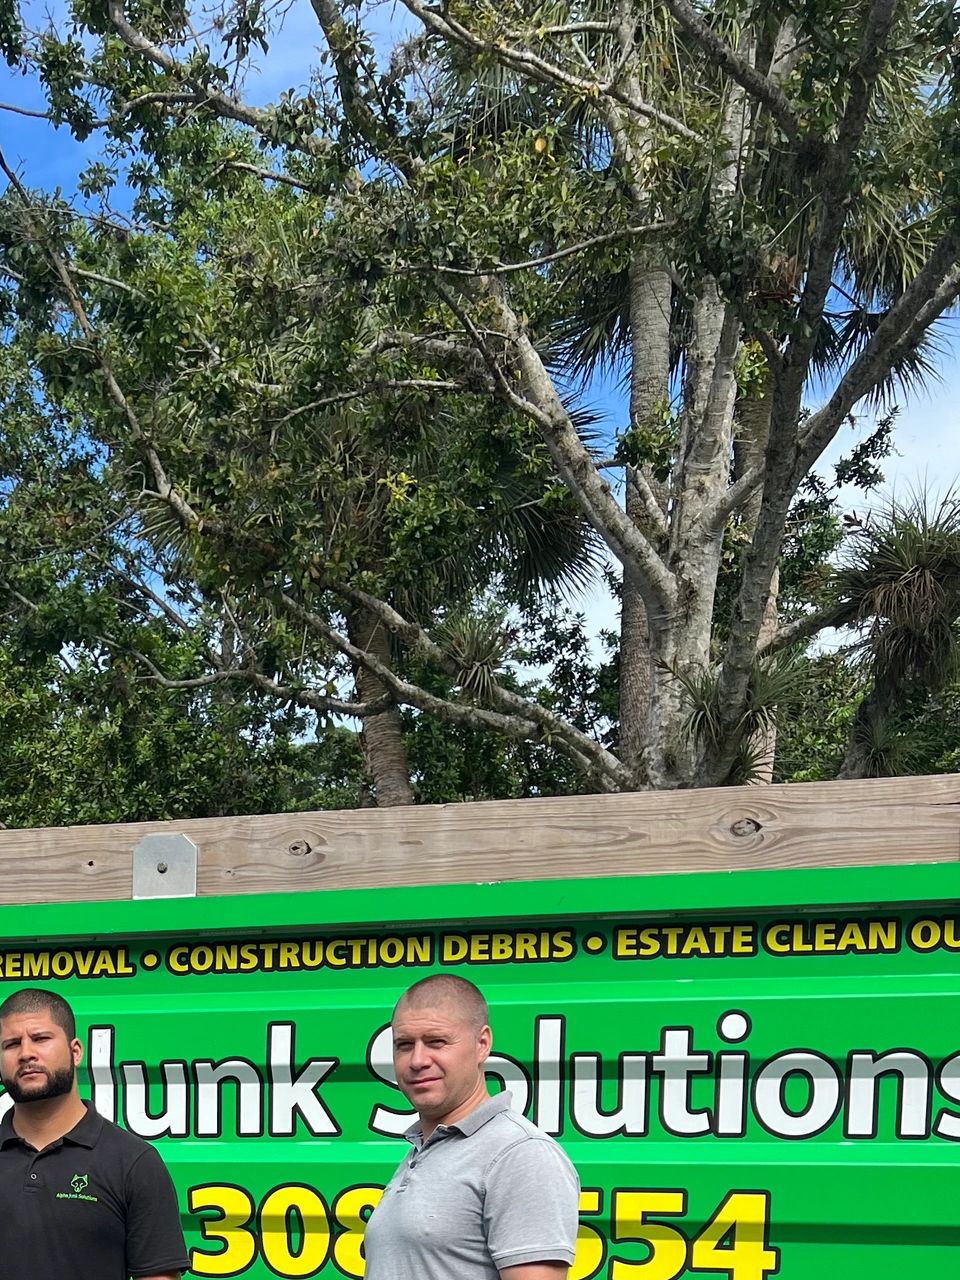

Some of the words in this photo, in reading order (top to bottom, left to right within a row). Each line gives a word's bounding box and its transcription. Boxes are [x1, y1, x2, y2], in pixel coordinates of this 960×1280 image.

[169, 936, 430, 972] CONSTRUCTION
[443, 931, 573, 962] DEBRIS
[617, 925, 754, 956] ESTATE
[766, 921, 897, 952] CLEAN
[91, 1024, 339, 1136] Junk
